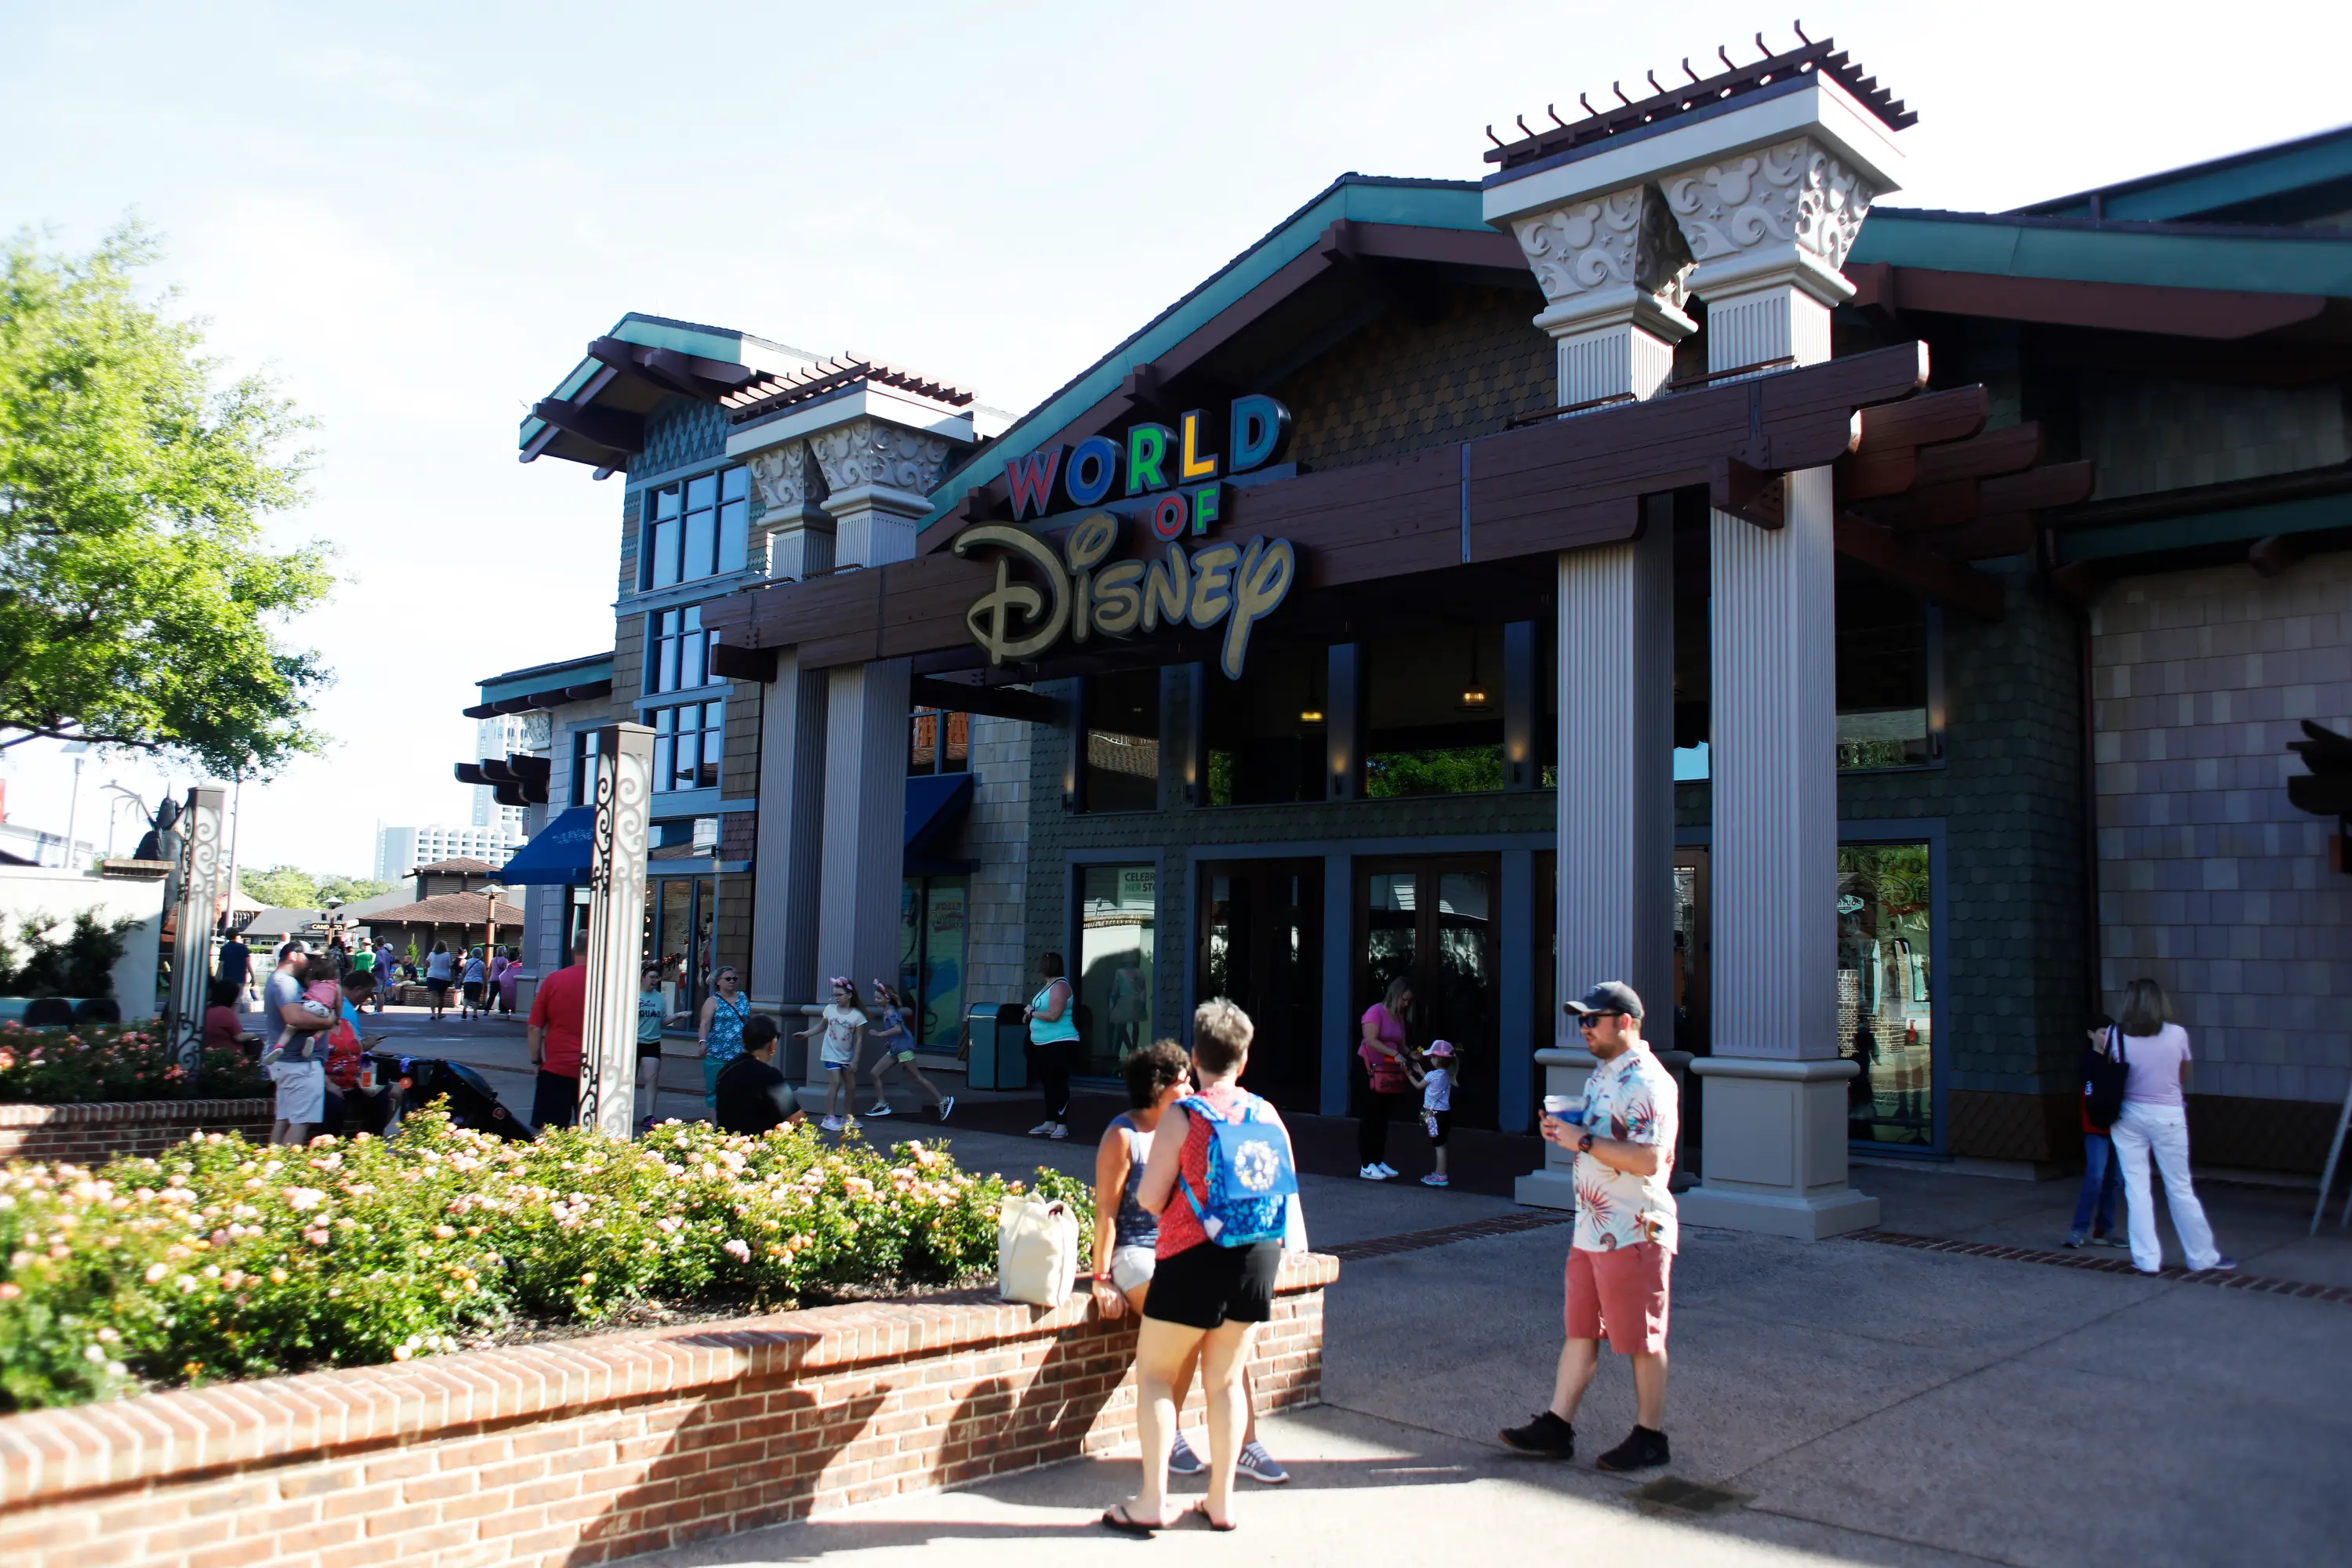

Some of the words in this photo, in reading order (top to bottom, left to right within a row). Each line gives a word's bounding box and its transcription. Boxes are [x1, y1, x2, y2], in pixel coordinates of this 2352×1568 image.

[1004, 394, 1290, 521] WORLD
[1151, 484, 1221, 541] OF
[951, 510, 1294, 681] DISNEY
[1125, 883, 1142, 891] HER
